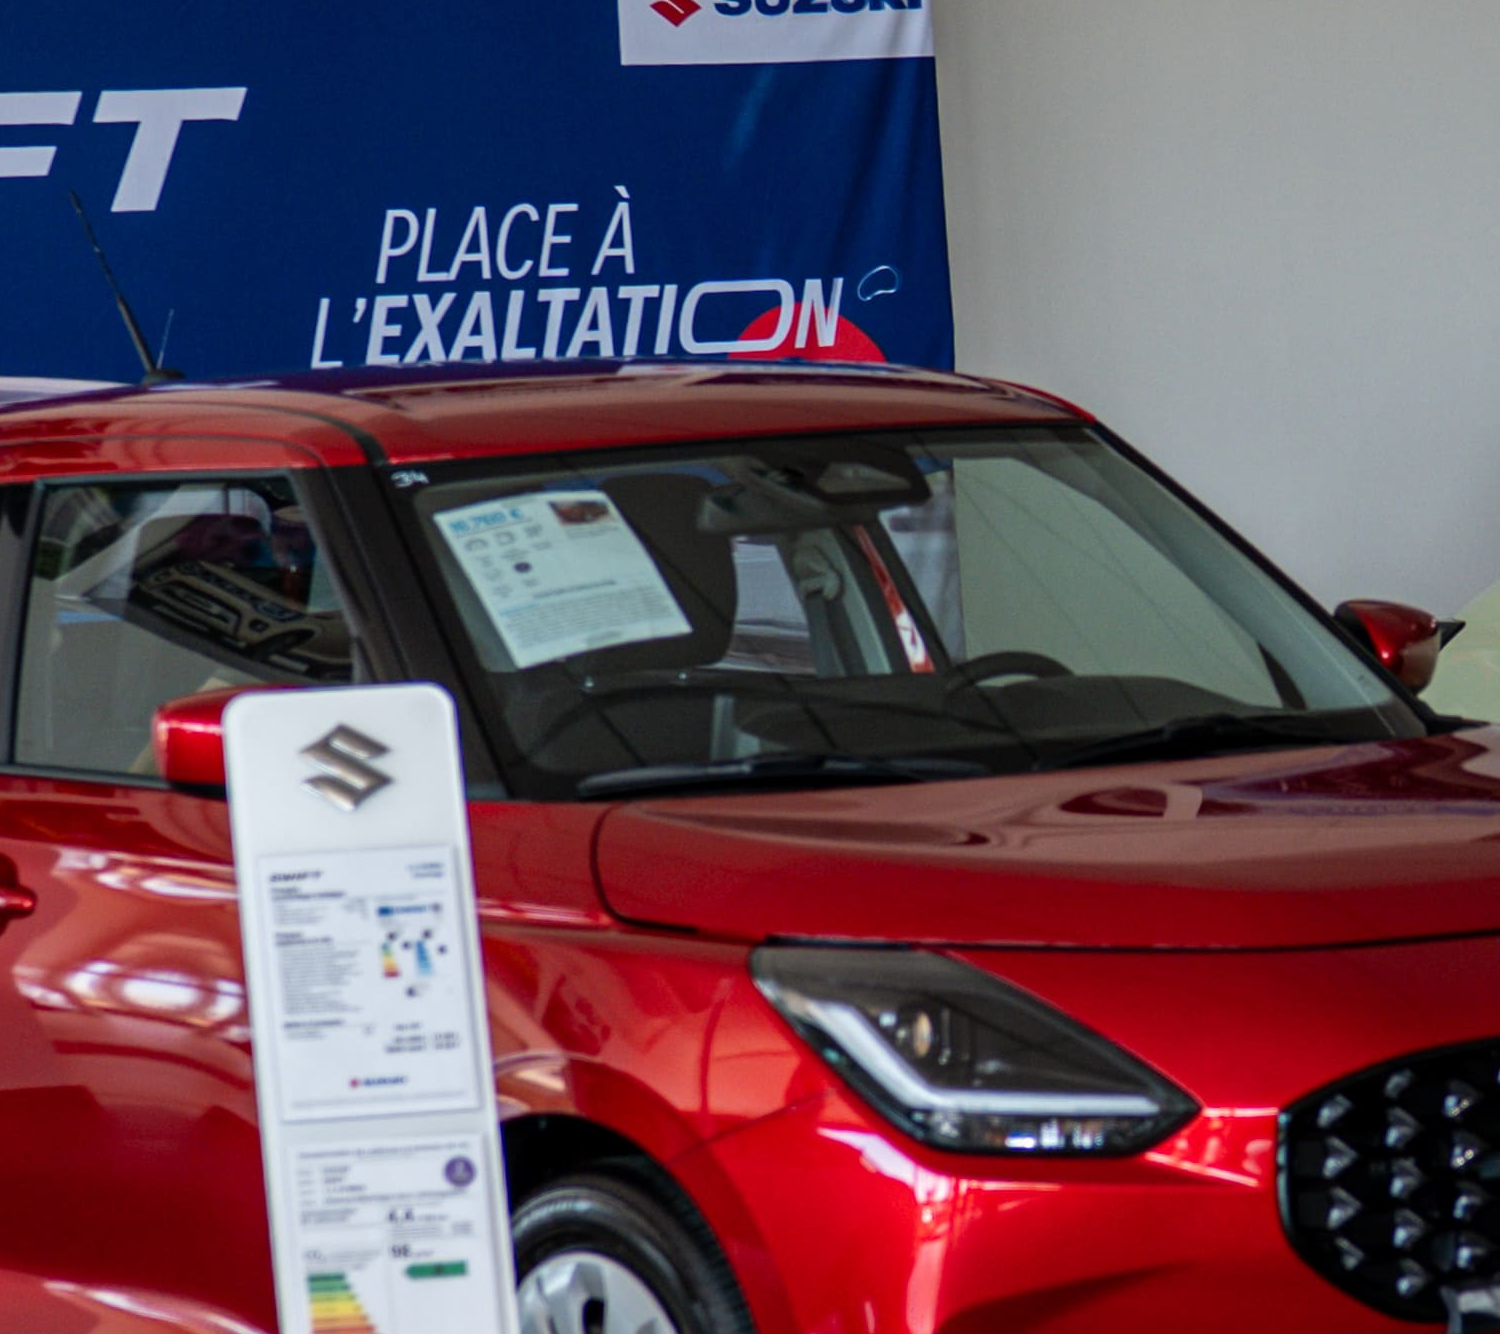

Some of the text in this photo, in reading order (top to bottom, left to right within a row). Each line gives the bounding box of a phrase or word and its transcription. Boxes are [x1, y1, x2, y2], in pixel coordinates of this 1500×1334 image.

[375, 185, 635, 284] PLACE À
[310, 276, 845, 369] L'EXALTATION
